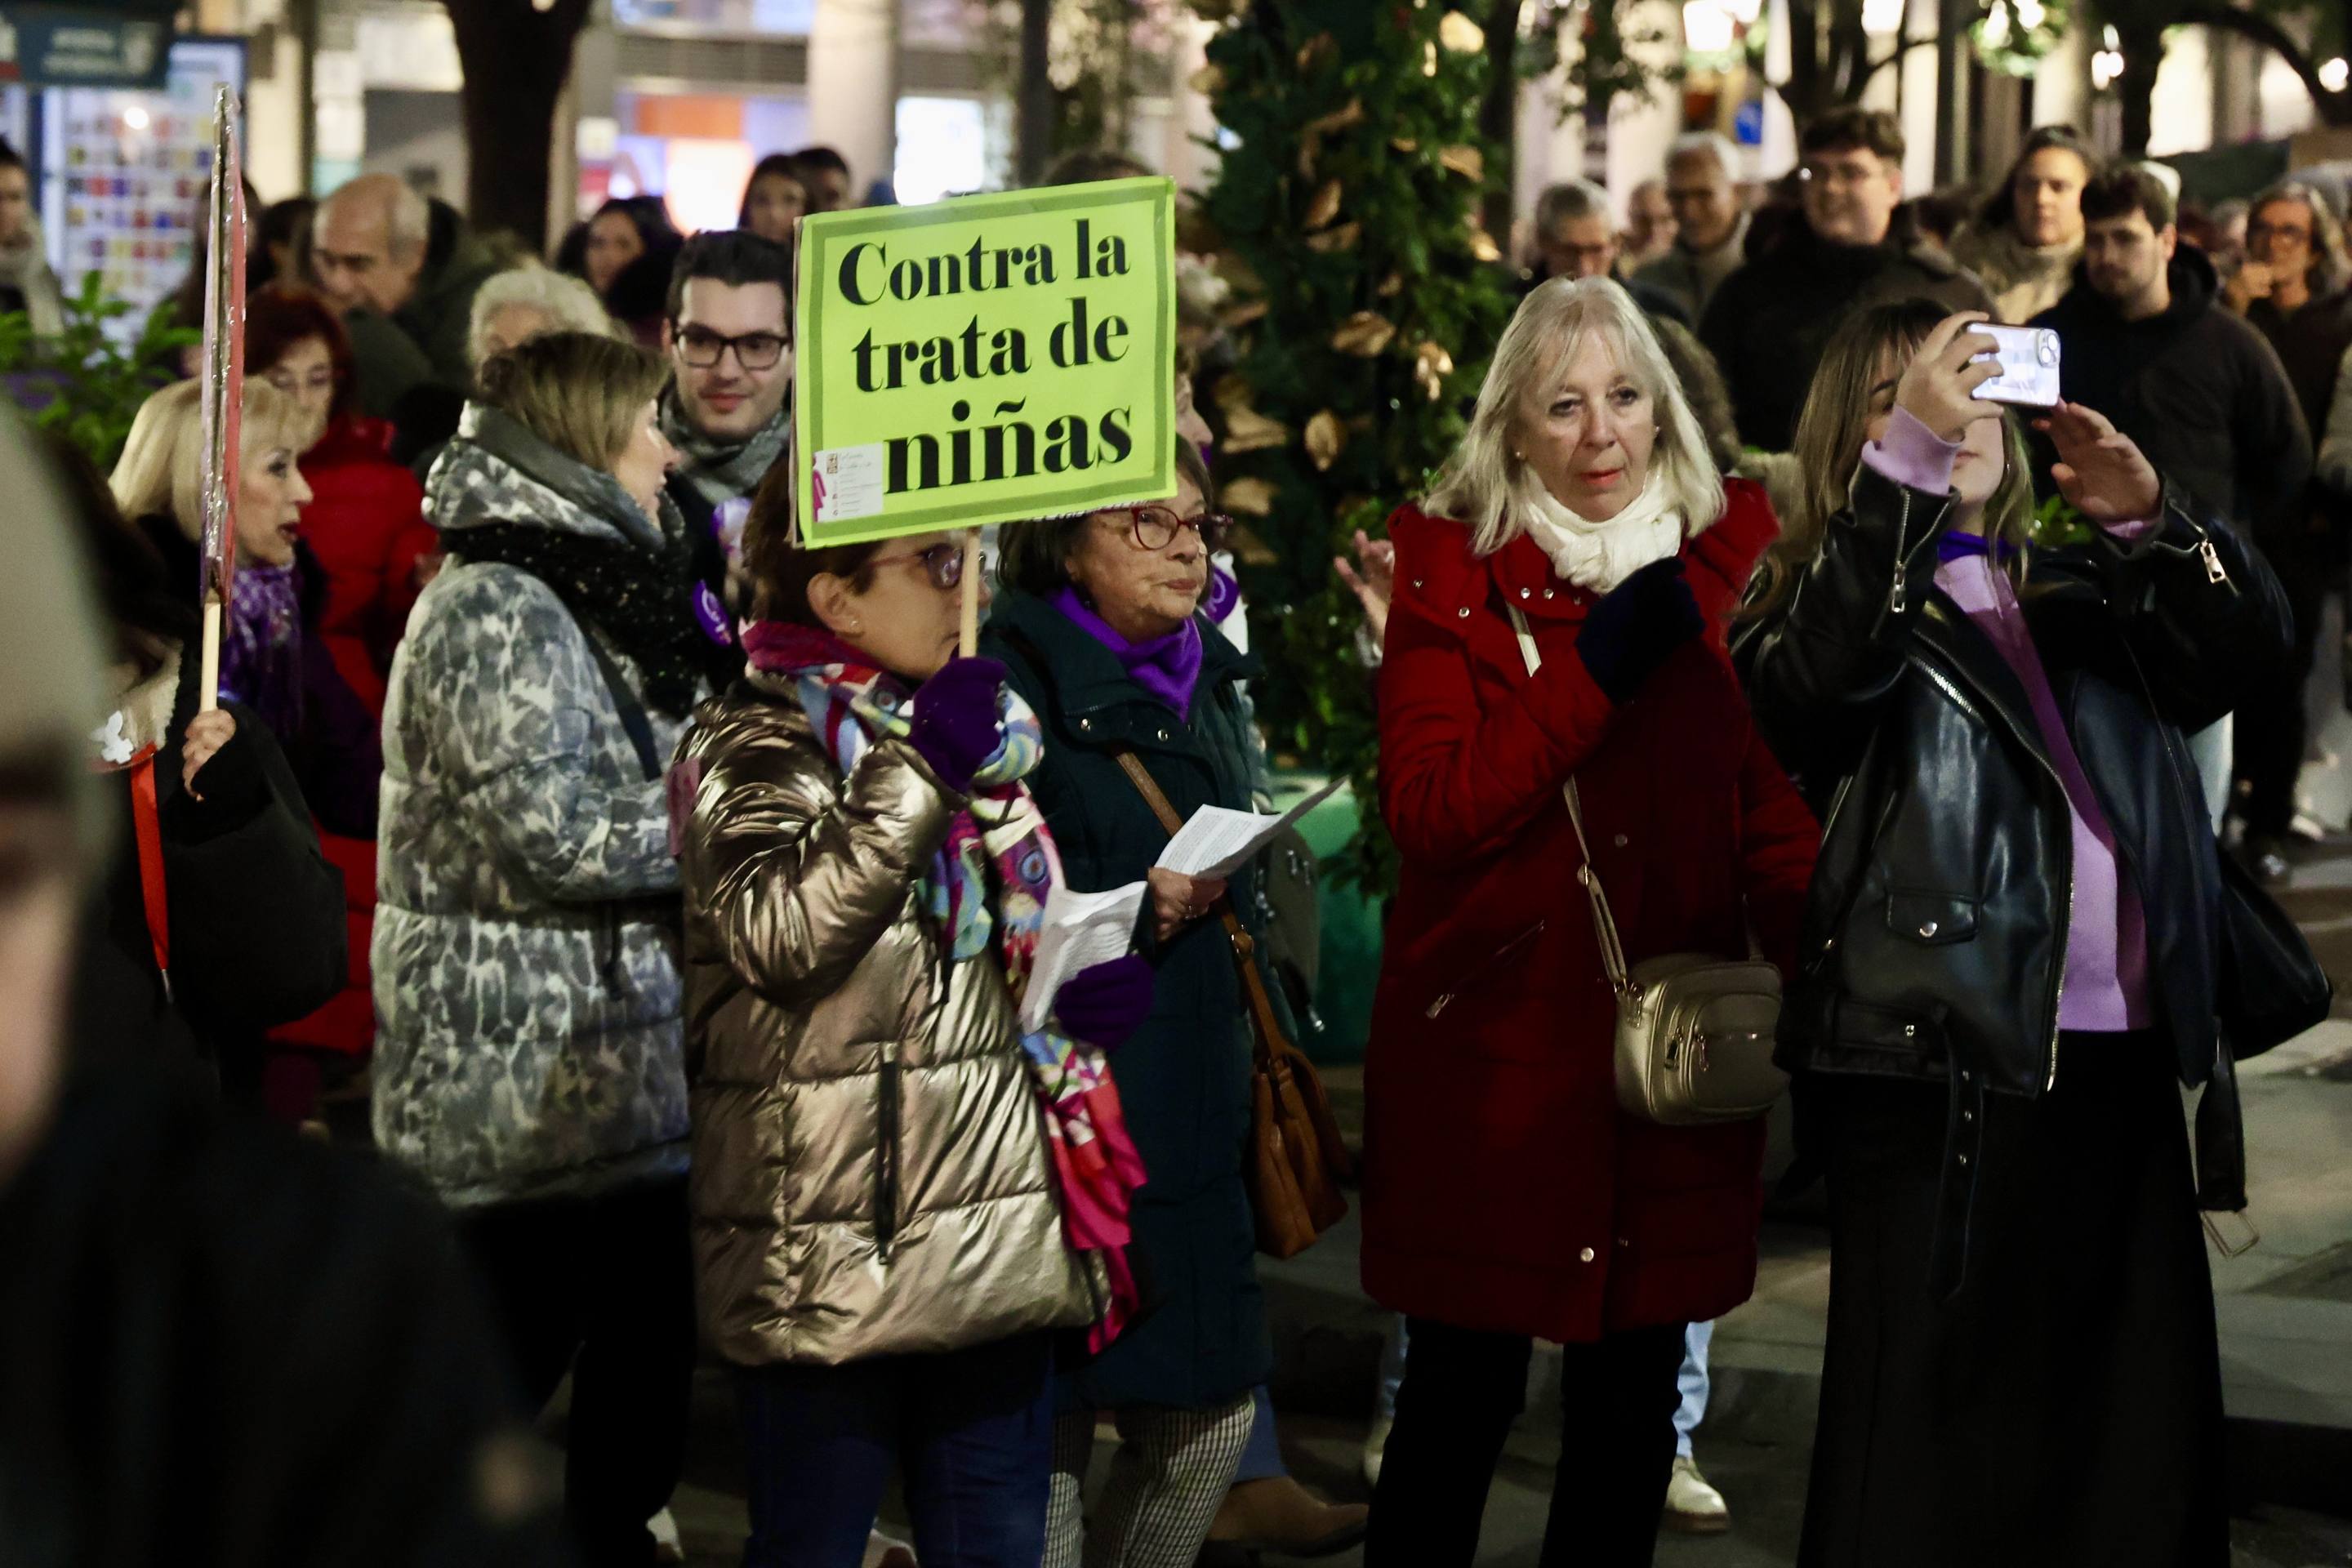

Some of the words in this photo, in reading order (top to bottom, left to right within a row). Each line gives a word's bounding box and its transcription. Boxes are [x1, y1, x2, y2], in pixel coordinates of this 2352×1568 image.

[837, 234, 1058, 306] Contra
[1073, 218, 1130, 279] la
[851, 314, 1032, 393] trata
[1049, 296, 1130, 367] de
[882, 396, 1133, 495] niñas
